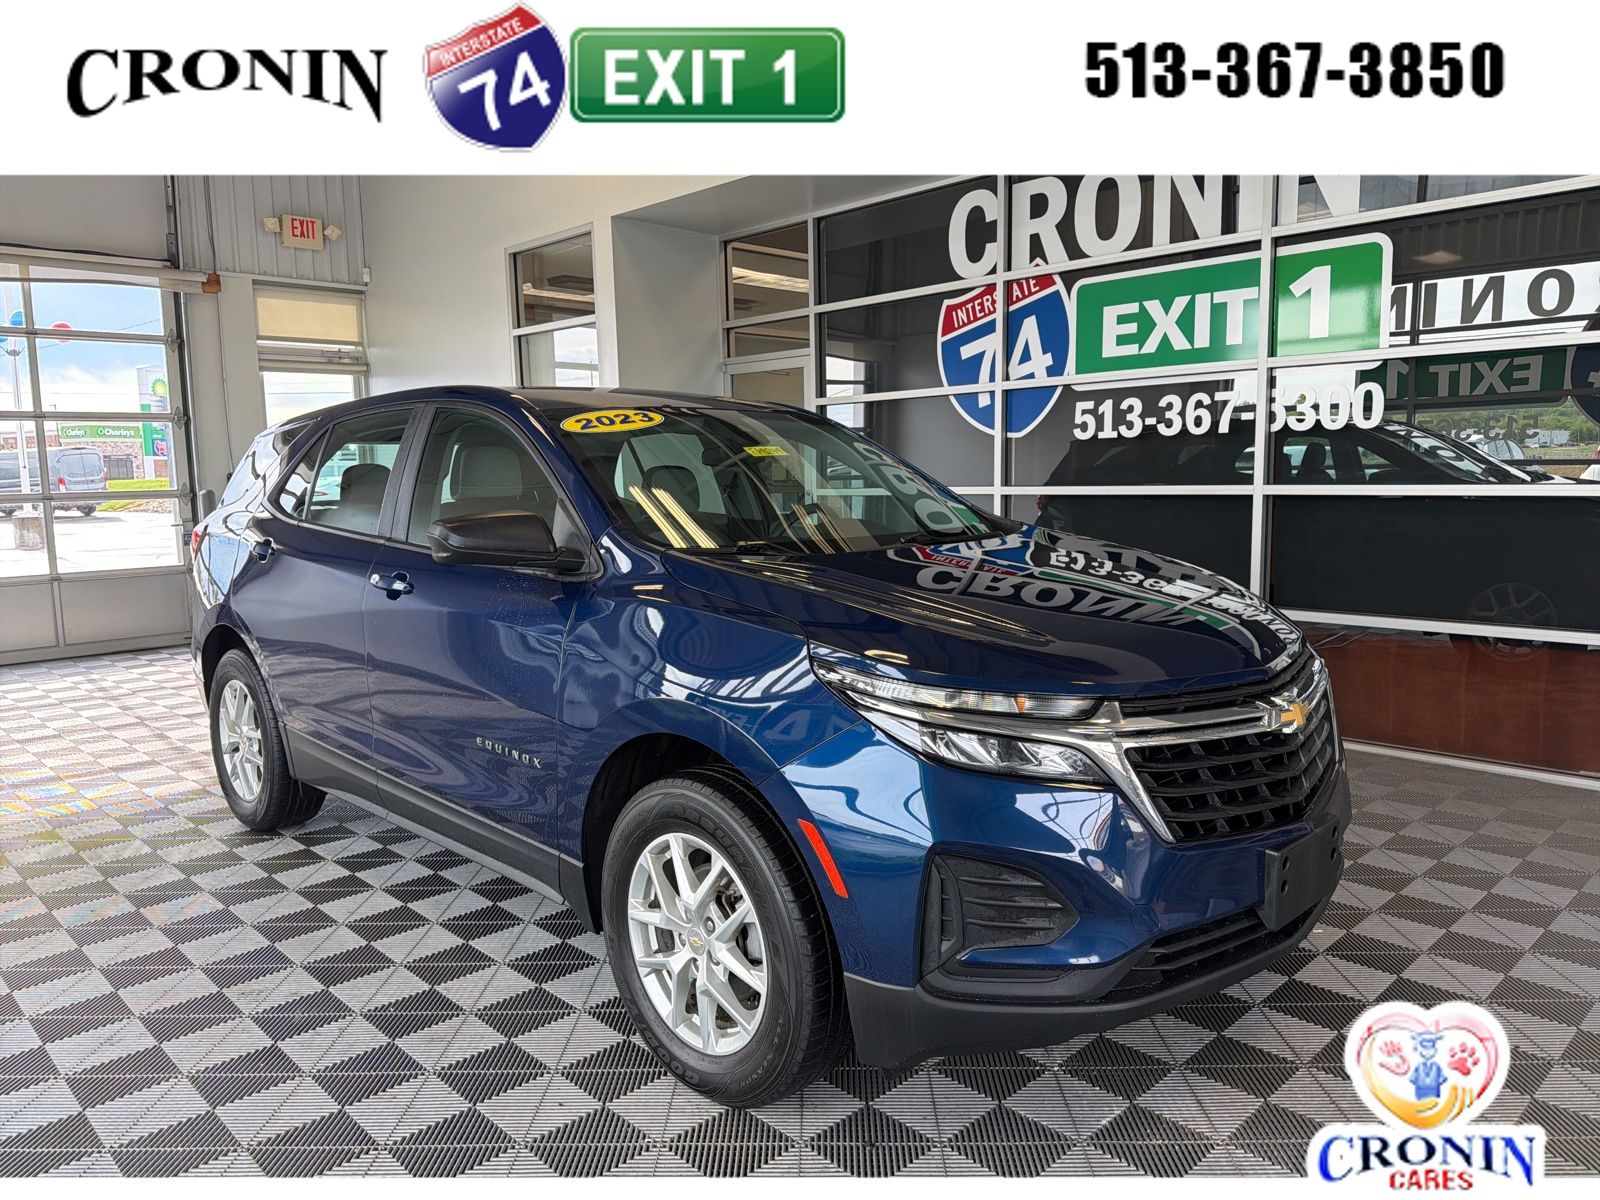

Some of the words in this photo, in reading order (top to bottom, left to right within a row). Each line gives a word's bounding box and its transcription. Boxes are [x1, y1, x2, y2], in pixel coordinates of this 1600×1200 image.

[291, 217, 317, 240] EXIT
[948, 174, 1361, 279] CRONIN
[953, 278, 1040, 328] INTERSATE
[1102, 286, 1259, 359] EXIT
[1288, 265, 1333, 340] 1
[959, 314, 1054, 409] 74
[575, 412, 655, 430] 2023
[476, 736, 541, 769] EQUINOX
